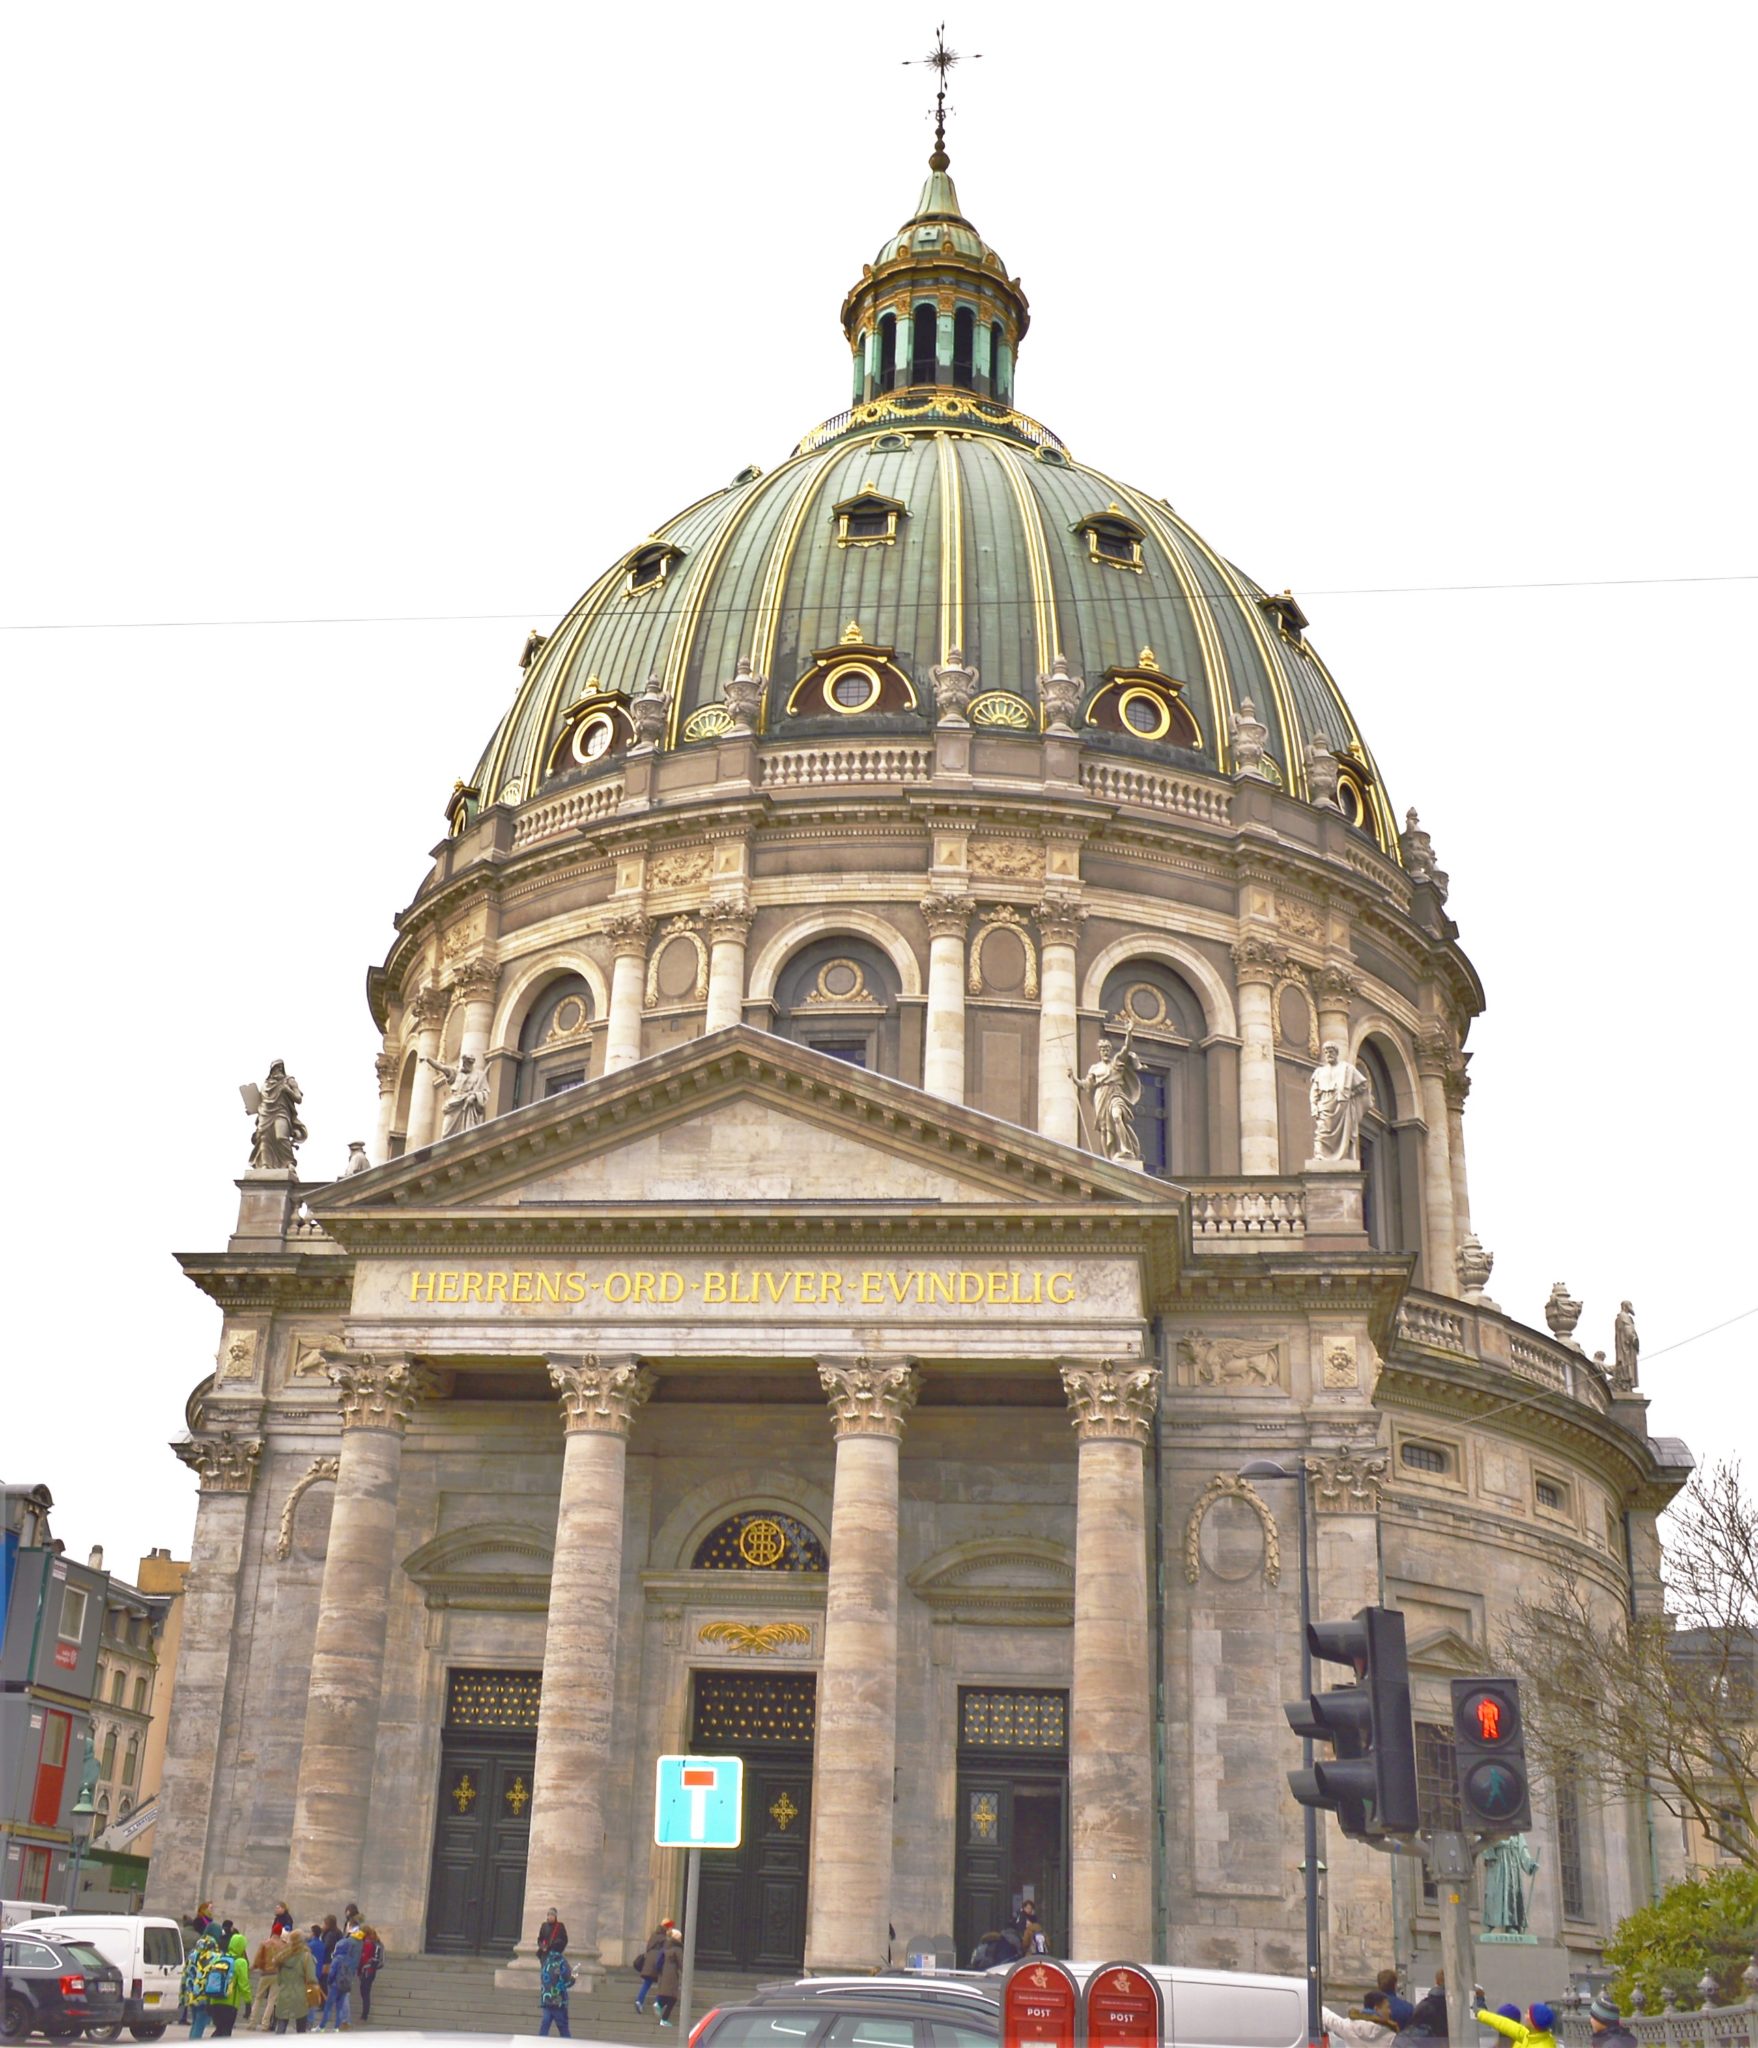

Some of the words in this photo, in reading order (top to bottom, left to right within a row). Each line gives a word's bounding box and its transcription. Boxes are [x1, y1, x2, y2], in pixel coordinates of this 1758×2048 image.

[410, 1271, 588, 1303] HERRENS
[603, 1271, 685, 1304] ORD
[703, 1271, 845, 1304] BLIVER
[861, 1271, 1076, 1304] EVINDELIG
[1027, 2008, 1051, 2018] POST
[1110, 2013, 1134, 2023] POST
